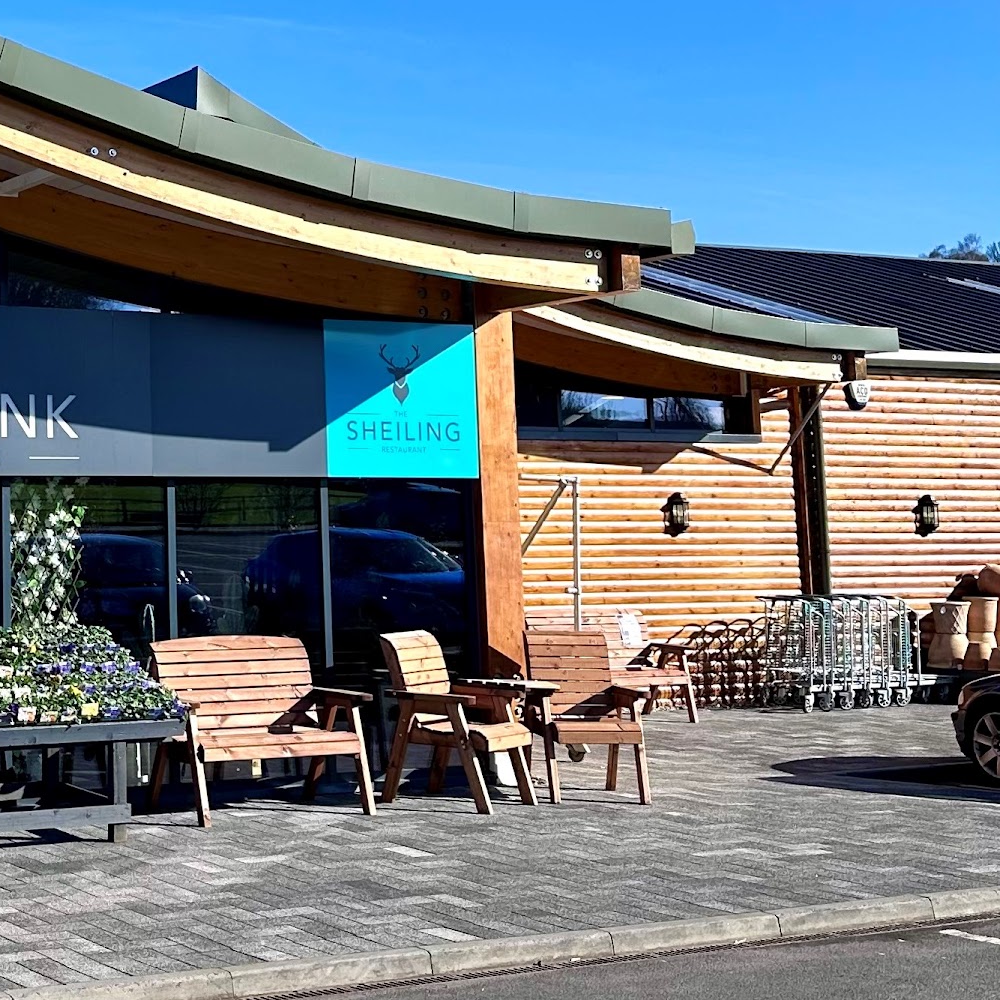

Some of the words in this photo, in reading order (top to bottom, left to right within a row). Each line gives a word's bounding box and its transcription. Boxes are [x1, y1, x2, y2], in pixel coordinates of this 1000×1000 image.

[394, 410, 408, 418] THE
[347, 420, 460, 442] SHEILING
[381, 446, 427, 454] RESTAURANT
